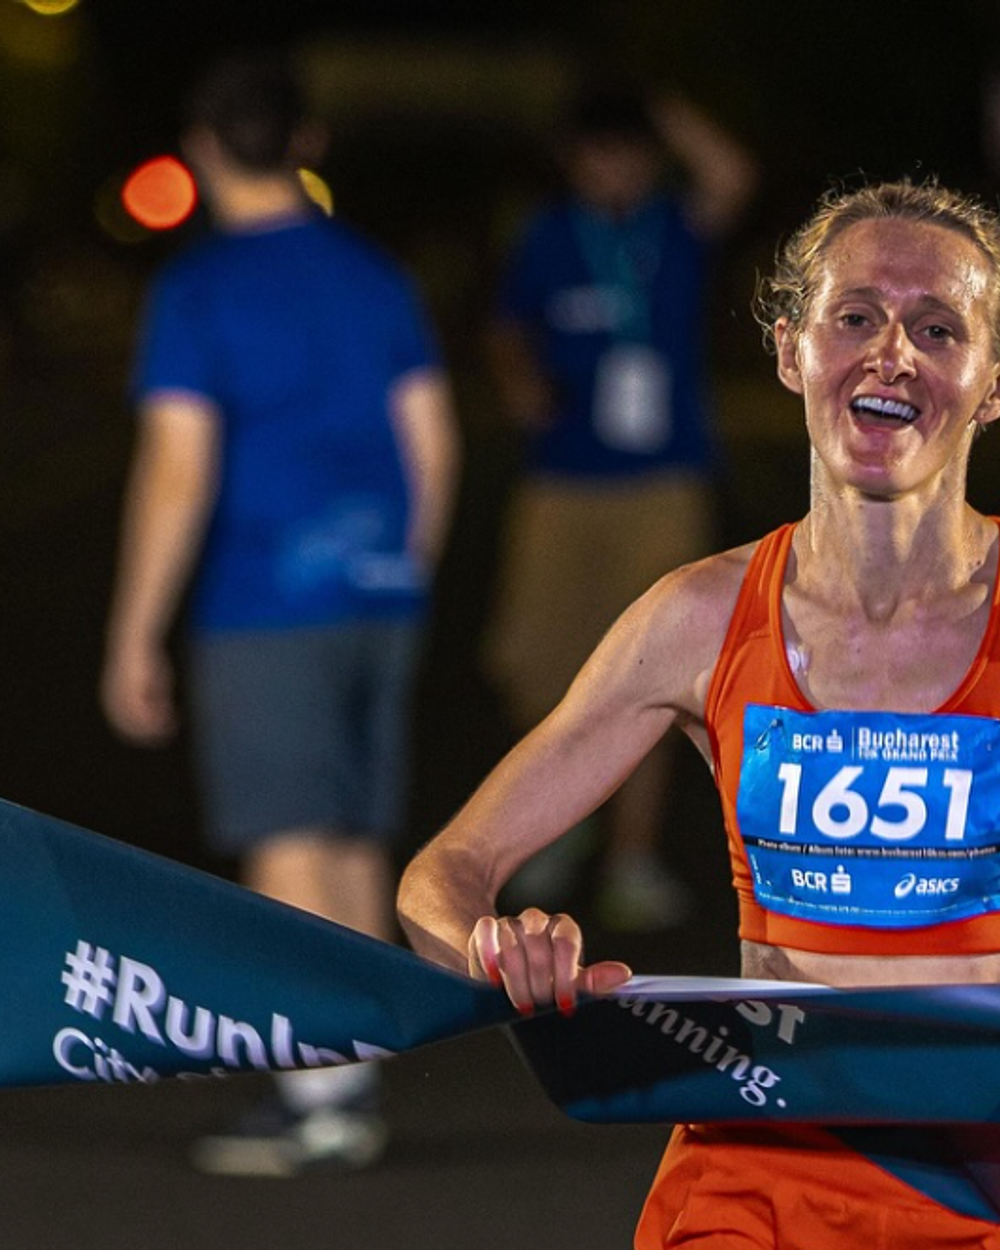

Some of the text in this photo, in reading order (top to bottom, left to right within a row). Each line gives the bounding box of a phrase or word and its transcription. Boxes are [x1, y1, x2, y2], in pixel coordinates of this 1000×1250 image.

[792, 726, 959, 752] BCR Bucharest
[882, 748, 927, 761] GRAND
[930, 749, 958, 762] PRIX
[778, 762, 973, 840] 1651
[791, 868, 828, 893] BCR
